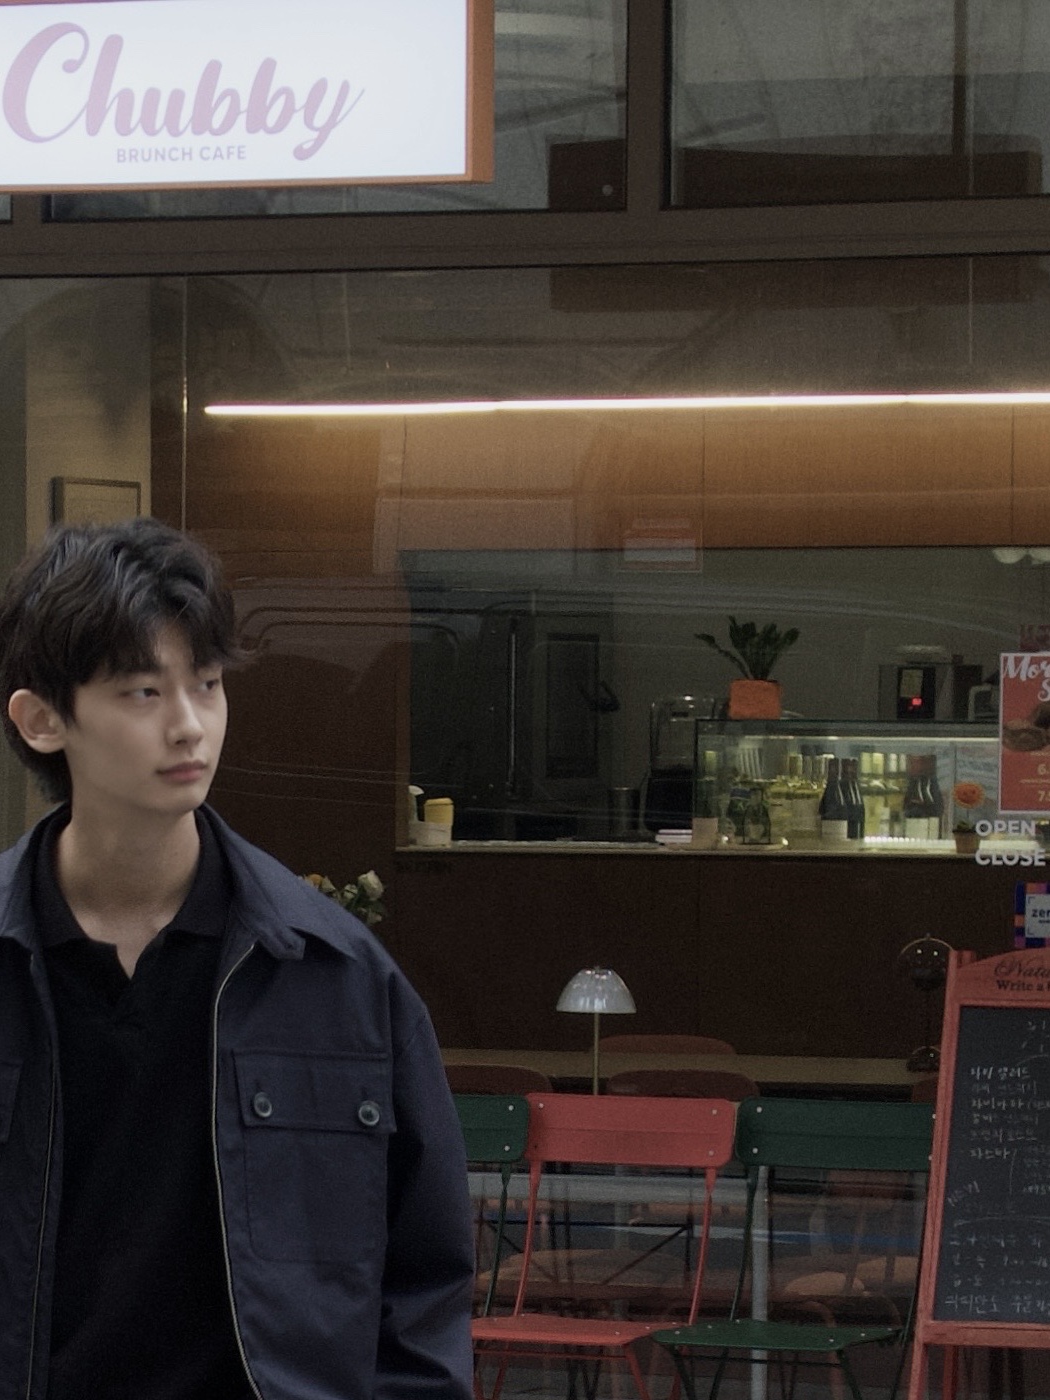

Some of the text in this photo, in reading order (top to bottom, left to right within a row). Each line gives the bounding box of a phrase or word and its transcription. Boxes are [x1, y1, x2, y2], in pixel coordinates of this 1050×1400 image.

[2, 22, 365, 161] Chubby
[116, 145, 247, 163] BRUNCH CAFE
[975, 819, 1036, 837] OPEN
[975, 849, 1046, 866] CLOSE
[996, 980, 1033, 991] Write
